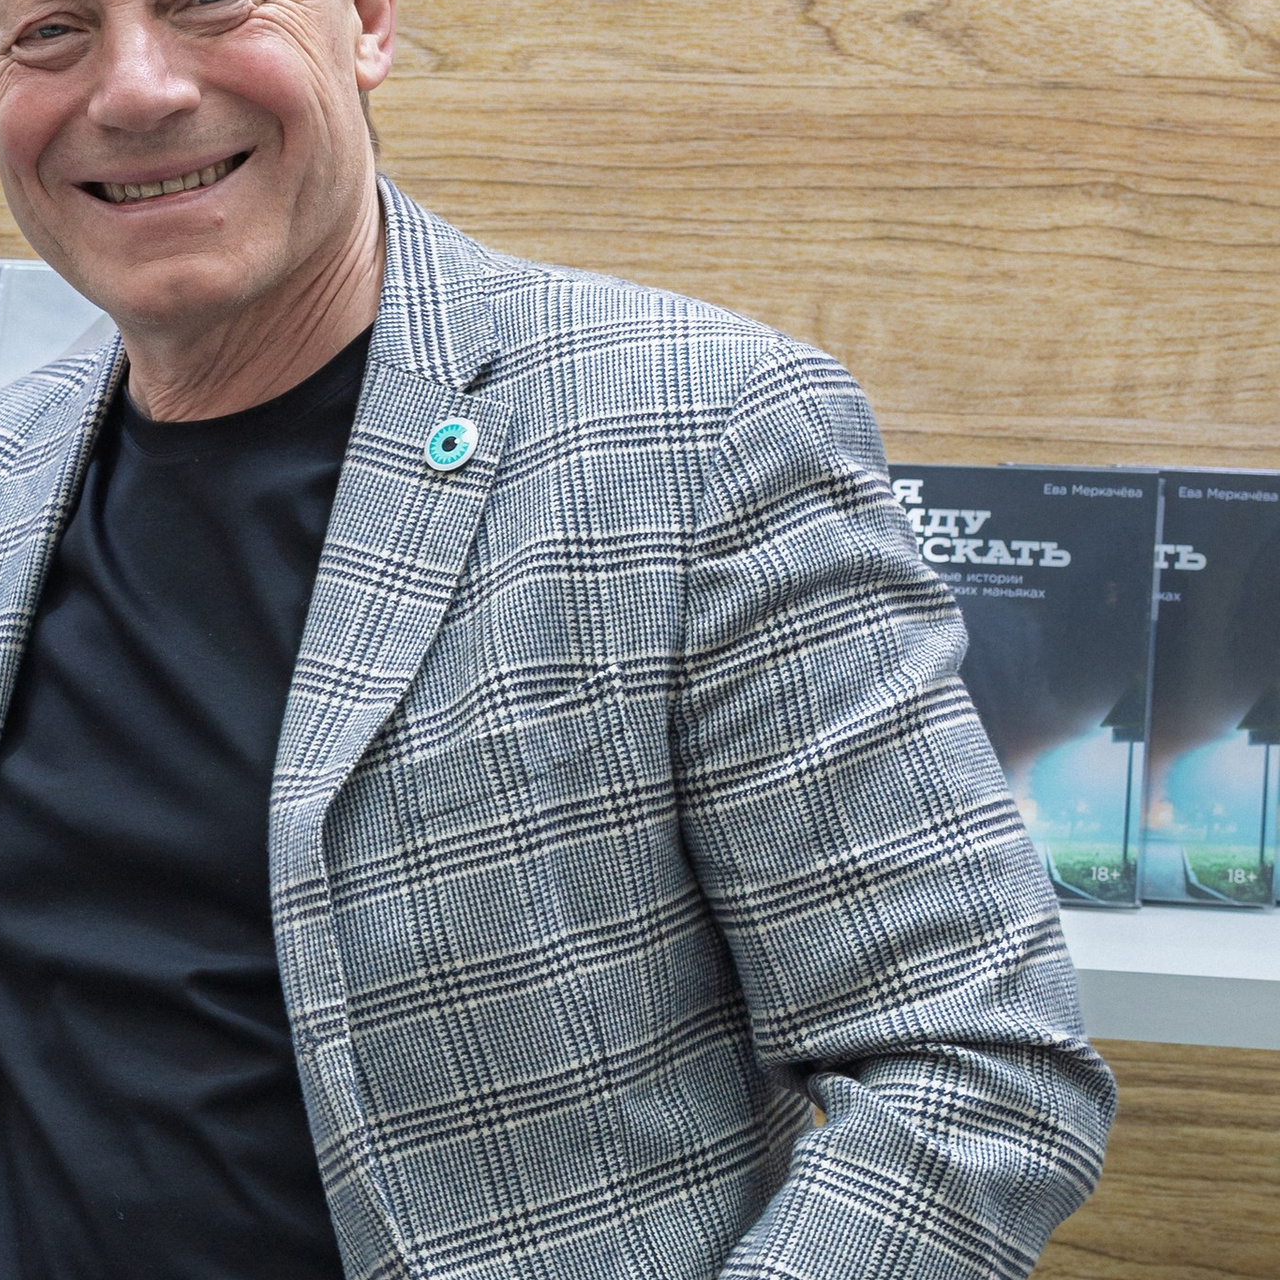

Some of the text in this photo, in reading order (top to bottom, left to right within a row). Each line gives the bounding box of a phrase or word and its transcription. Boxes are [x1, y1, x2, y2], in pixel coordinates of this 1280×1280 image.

[892, 479, 924, 504] Я
[1043, 483, 1143, 498] Ева Меркачёва
[1178, 486, 1278, 503] Ева Меркачёва
[917, 536, 1072, 568] СКАТЬ
[966, 573, 1023, 585] истории
[982, 587, 1046, 599] маньяках
[1090, 866, 1121, 881] 18+
[1226, 868, 1257, 884] 18+
